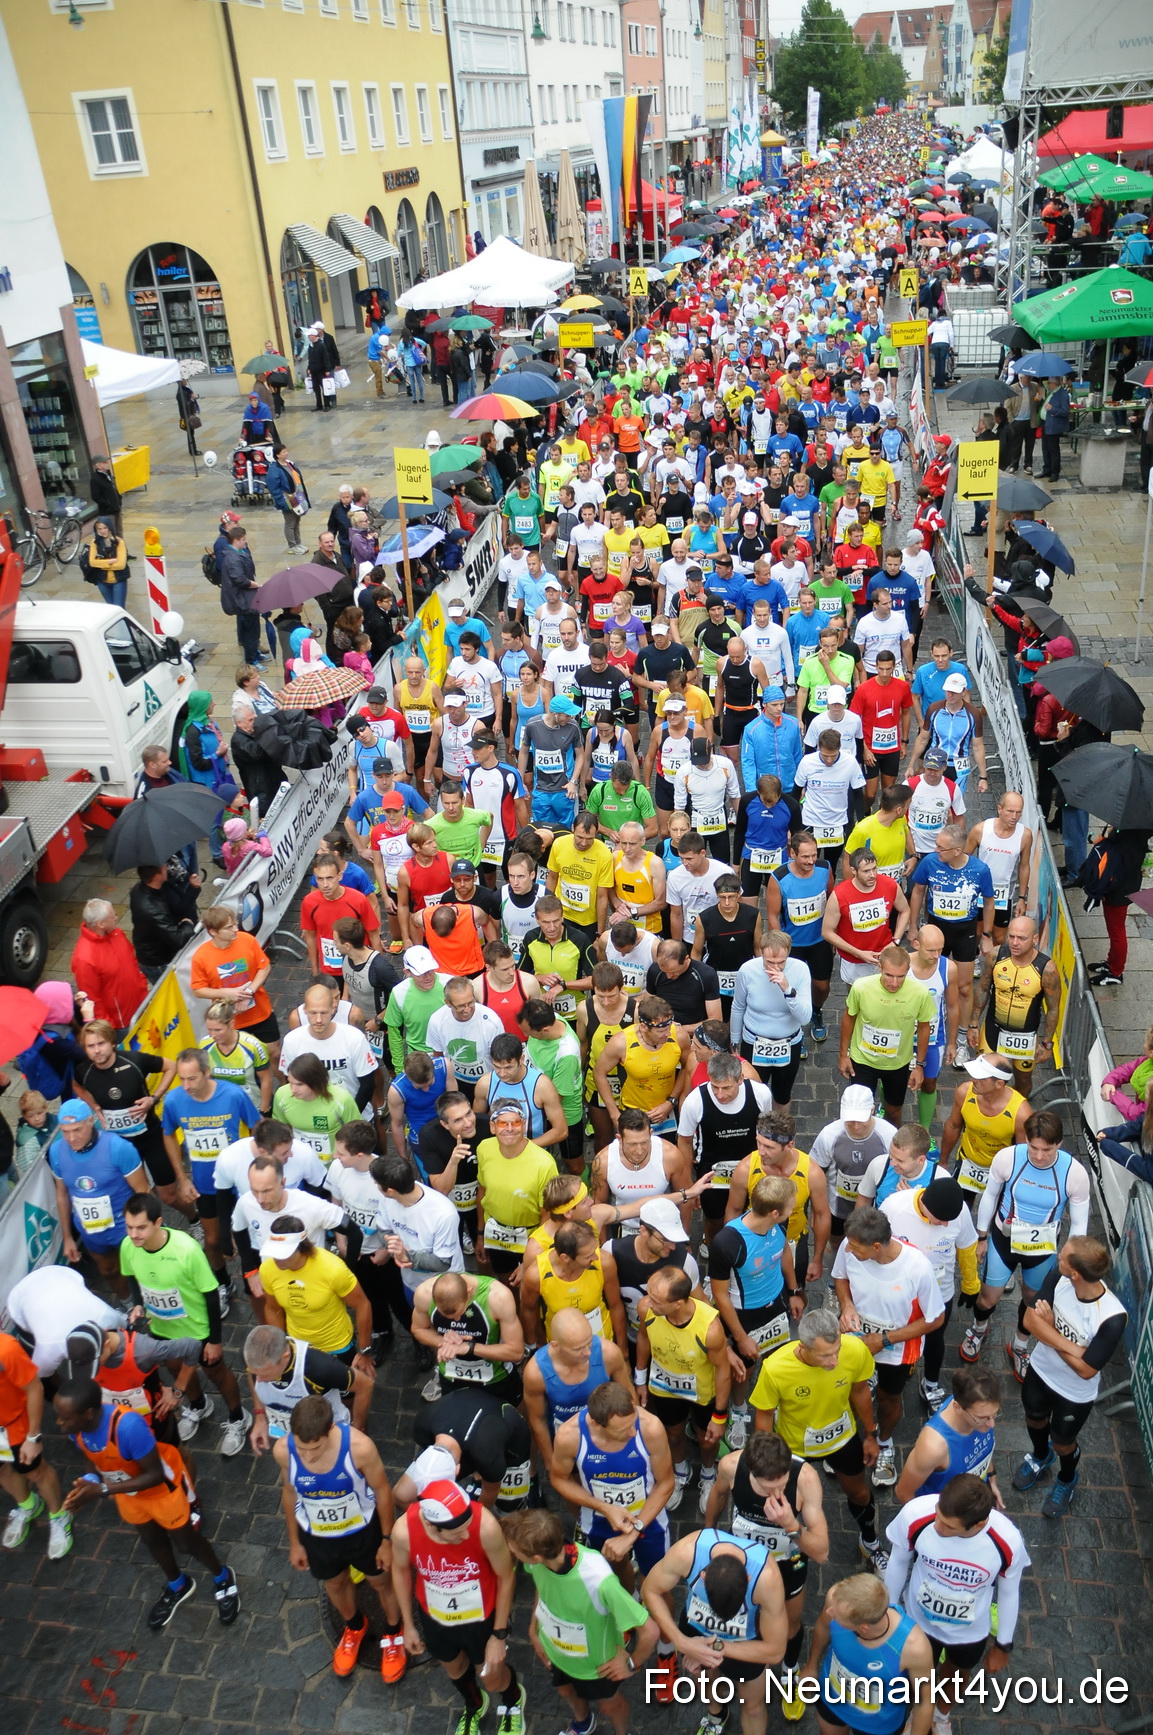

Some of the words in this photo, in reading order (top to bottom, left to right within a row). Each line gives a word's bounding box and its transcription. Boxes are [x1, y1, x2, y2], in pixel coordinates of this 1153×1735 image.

[755, 39, 766, 94] HOTEL
[633, 276, 644, 290] A
[904, 278, 915, 292] A
[1098, 306, 1153, 314] Neumarkter
[560, 331, 592, 339] Schnupper-
[396, 463, 430, 475] Jugend-
[959, 458, 998, 469] Jugend-
[406, 474, 422, 483] lauf
[969, 469, 988, 478] lauf
[821, 601, 841, 611] 2337
[580, 686, 614, 699] THULE
[407, 715, 429, 725] 3167
[875, 732, 896, 742] 2293
[537, 755, 561, 766] 2614
[594, 755, 615, 765] 2613
[669, 759, 682, 770] 75
[702, 816, 720, 826] 341
[918, 813, 942, 825] 2165
[822, 827, 835, 838] 52
[266, 829, 295, 888] BMW
[565, 889, 583, 902] 439
[795, 903, 815, 916] 114
[939, 899, 961, 911] 342
[858, 907, 881, 922] 236
[610, 959, 646, 971] SIEMENS
[871, 1034, 889, 1048] 59
[1005, 1036, 1029, 1049] 509
[757, 1044, 788, 1057] 2225
[455, 1064, 485, 1077] 2740
[194, 1137, 220, 1150] 414
[82, 1206, 100, 1220] 96
[1030, 1229, 1040, 1243] 2
[1021, 1243, 1047, 1251] Michael
[450, 1321, 468, 1329] DAV
[454, 1366, 483, 1380] 541
[963, 1431, 992, 1464] ELOTEC
[608, 1471, 639, 1479] QUELLE
[318, 1489, 347, 1497] QUELLE
[602, 1491, 637, 1507] 543
[317, 1506, 349, 1523] 487
[752, 1525, 781, 1537] Neumarkt
[921, 1554, 978, 1577] GERHART
[944, 1571, 983, 1584] JANIG
[446, 1597, 460, 1611] 4
[921, 1591, 970, 1620] 2002
[445, 1613, 463, 1622] Uwe
[552, 1625, 562, 1639] 1
